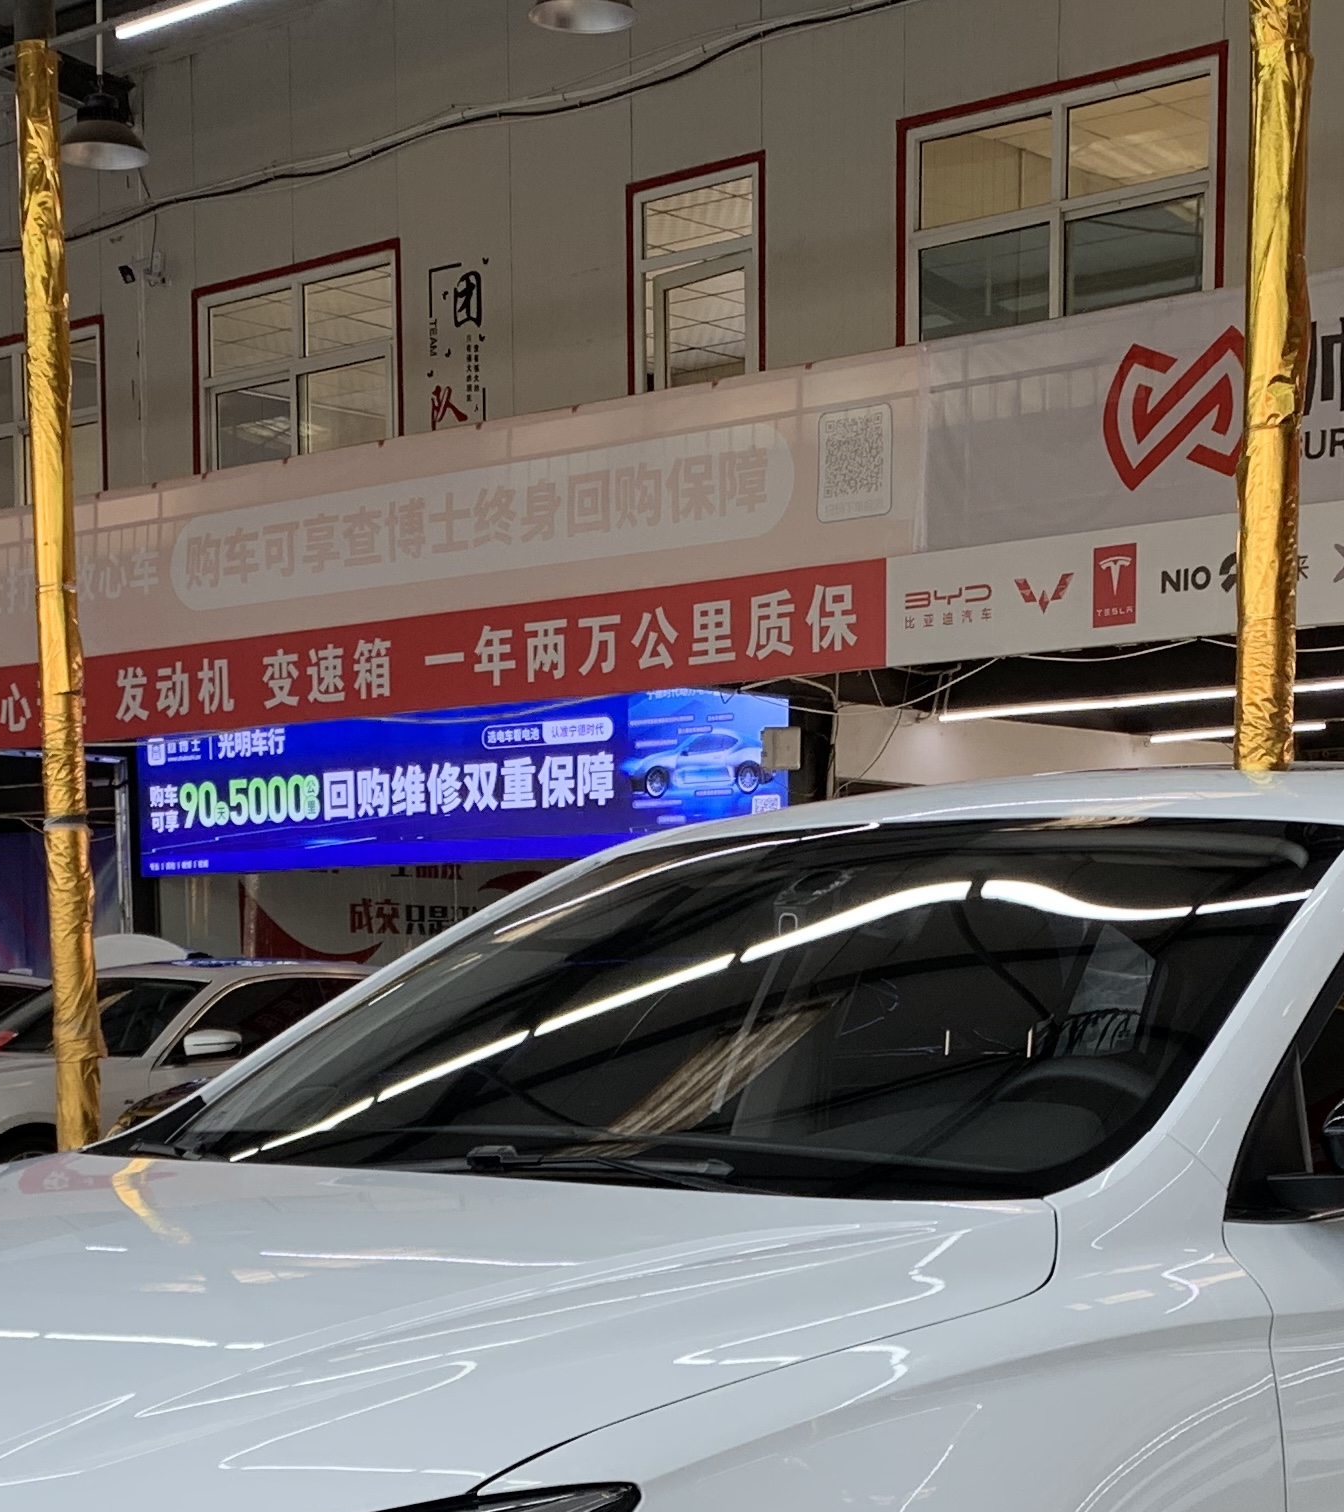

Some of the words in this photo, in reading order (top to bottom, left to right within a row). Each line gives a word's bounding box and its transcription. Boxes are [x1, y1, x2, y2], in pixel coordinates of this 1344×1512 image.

[185, 446, 769, 591] 购车可享查博士终身回购保障
[1161, 565, 1212, 594] NIO
[905, 584, 993, 610] BYD
[905, 607, 992, 630] 比亚迪汽车
[1096, 606, 1135, 618] TESLA
[115, 657, 235, 723] 发动机
[262, 638, 393, 708] 变速箱
[423, 584, 859, 686] 一年两万公里质保
[217, 728, 287, 760] 光明车行
[150, 784, 179, 808] 购车
[179, 781, 218, 829] 90
[229, 774, 305, 826] 5000
[323, 751, 616, 821] 回购维修双重保障
[151, 810, 180, 834] 可享
